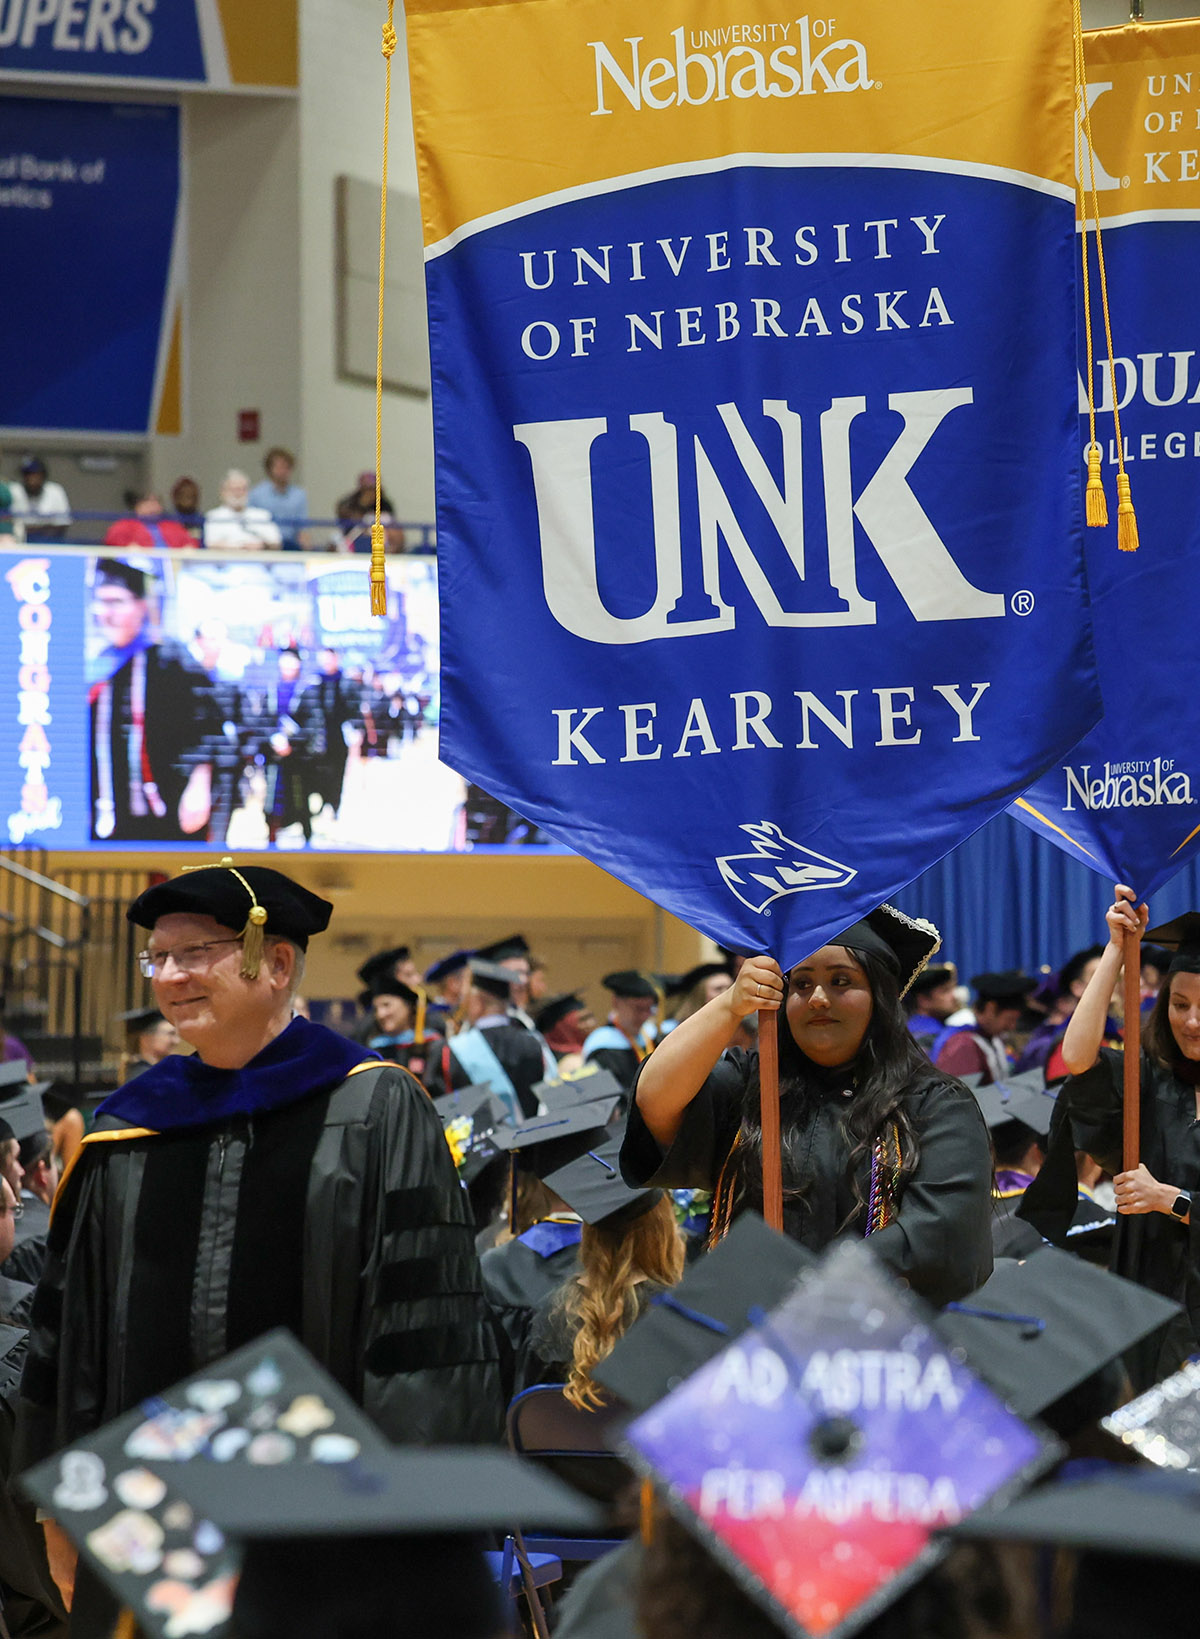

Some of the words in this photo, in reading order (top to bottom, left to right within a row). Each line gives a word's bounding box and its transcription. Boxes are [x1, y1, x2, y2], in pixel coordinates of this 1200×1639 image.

[587, 15, 875, 115] Nebraska
[690, 23, 790, 49] UNIVERSITY
[812, 19, 836, 38] OF
[1144, 111, 1183, 134] OF
[520, 214, 947, 291] UNIVERSITY
[521, 317, 598, 361] OF
[625, 287, 954, 354] NEBRASKA
[513, 387, 1006, 645] UNK
[551, 682, 991, 766] KEARNEY
[1061, 756, 1194, 811] Nebraska
[1110, 760, 1151, 776] UNIVERSITY
[1161, 759, 1175, 772] OF
[713, 1346, 788, 1406] AD
[801, 1349, 962, 1412] ASTRA
